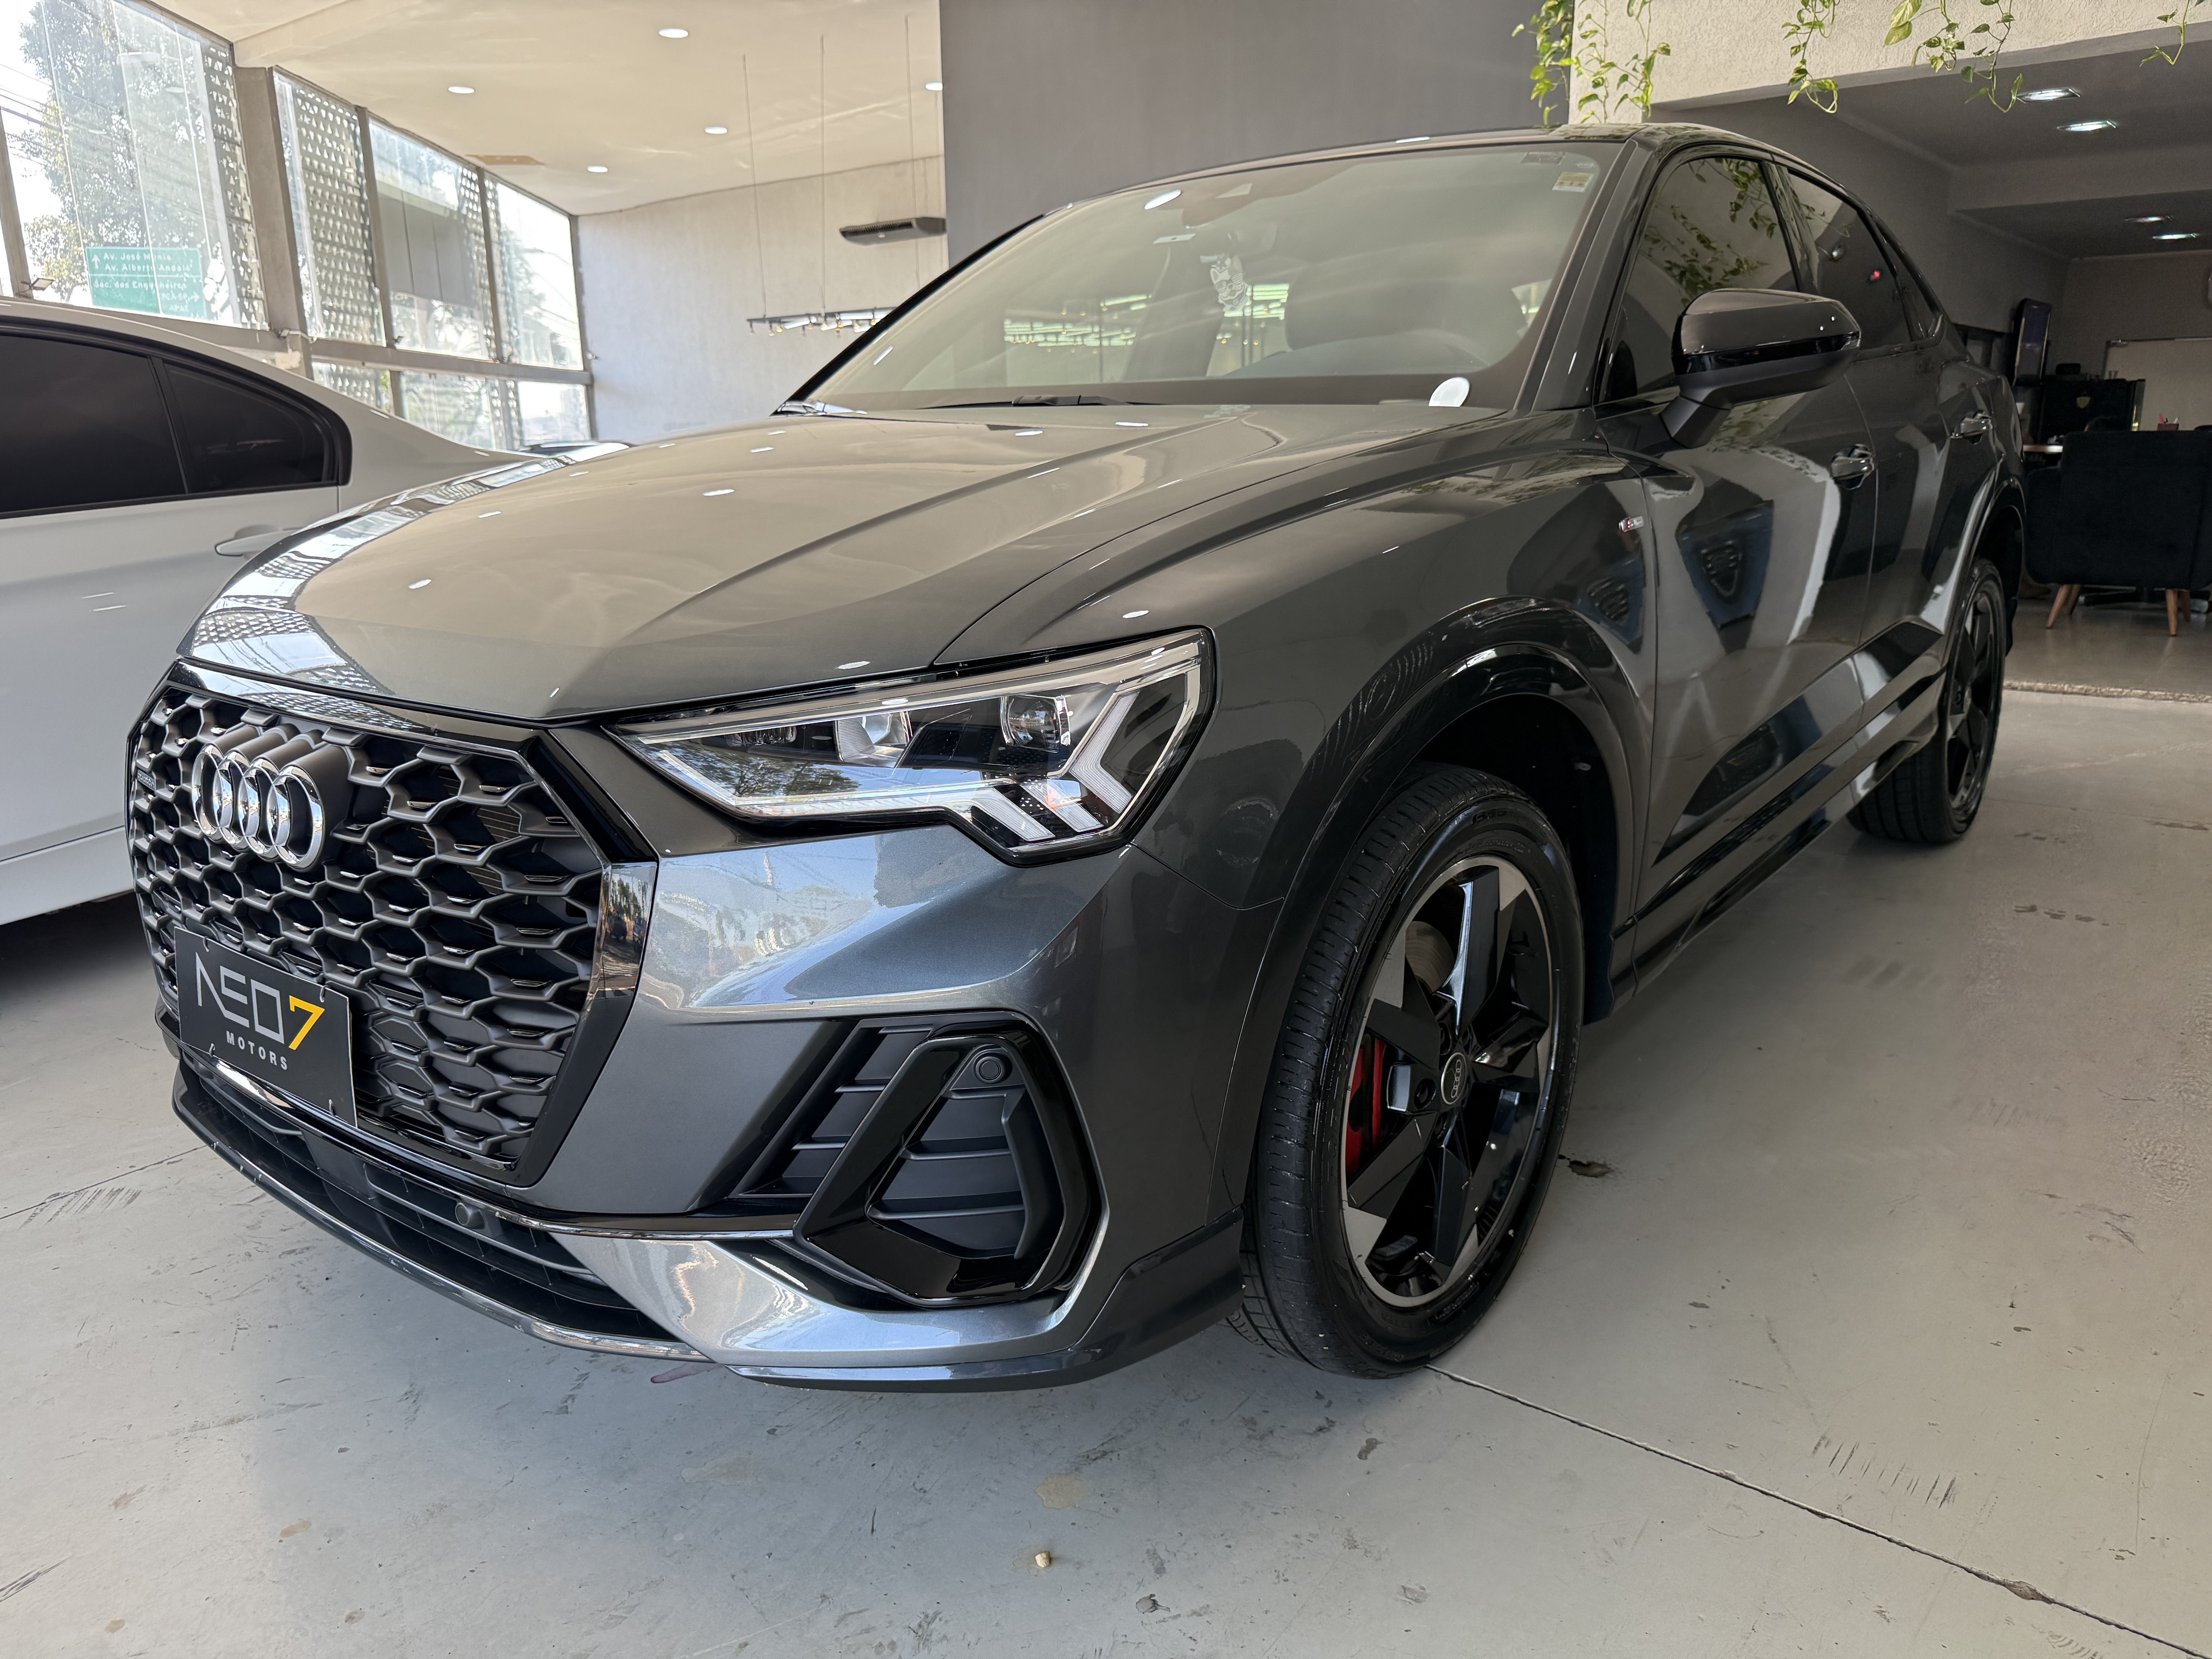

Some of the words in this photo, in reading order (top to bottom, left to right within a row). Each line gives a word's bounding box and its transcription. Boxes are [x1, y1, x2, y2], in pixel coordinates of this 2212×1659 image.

[103, 252, 117, 261] Av.
[121, 251, 141, 261] José
[144, 253, 172, 261] Mnia
[105, 263, 118, 271] Av.
[115, 280, 129, 289] dos
[227, 1030, 287, 1070] MOTORS
